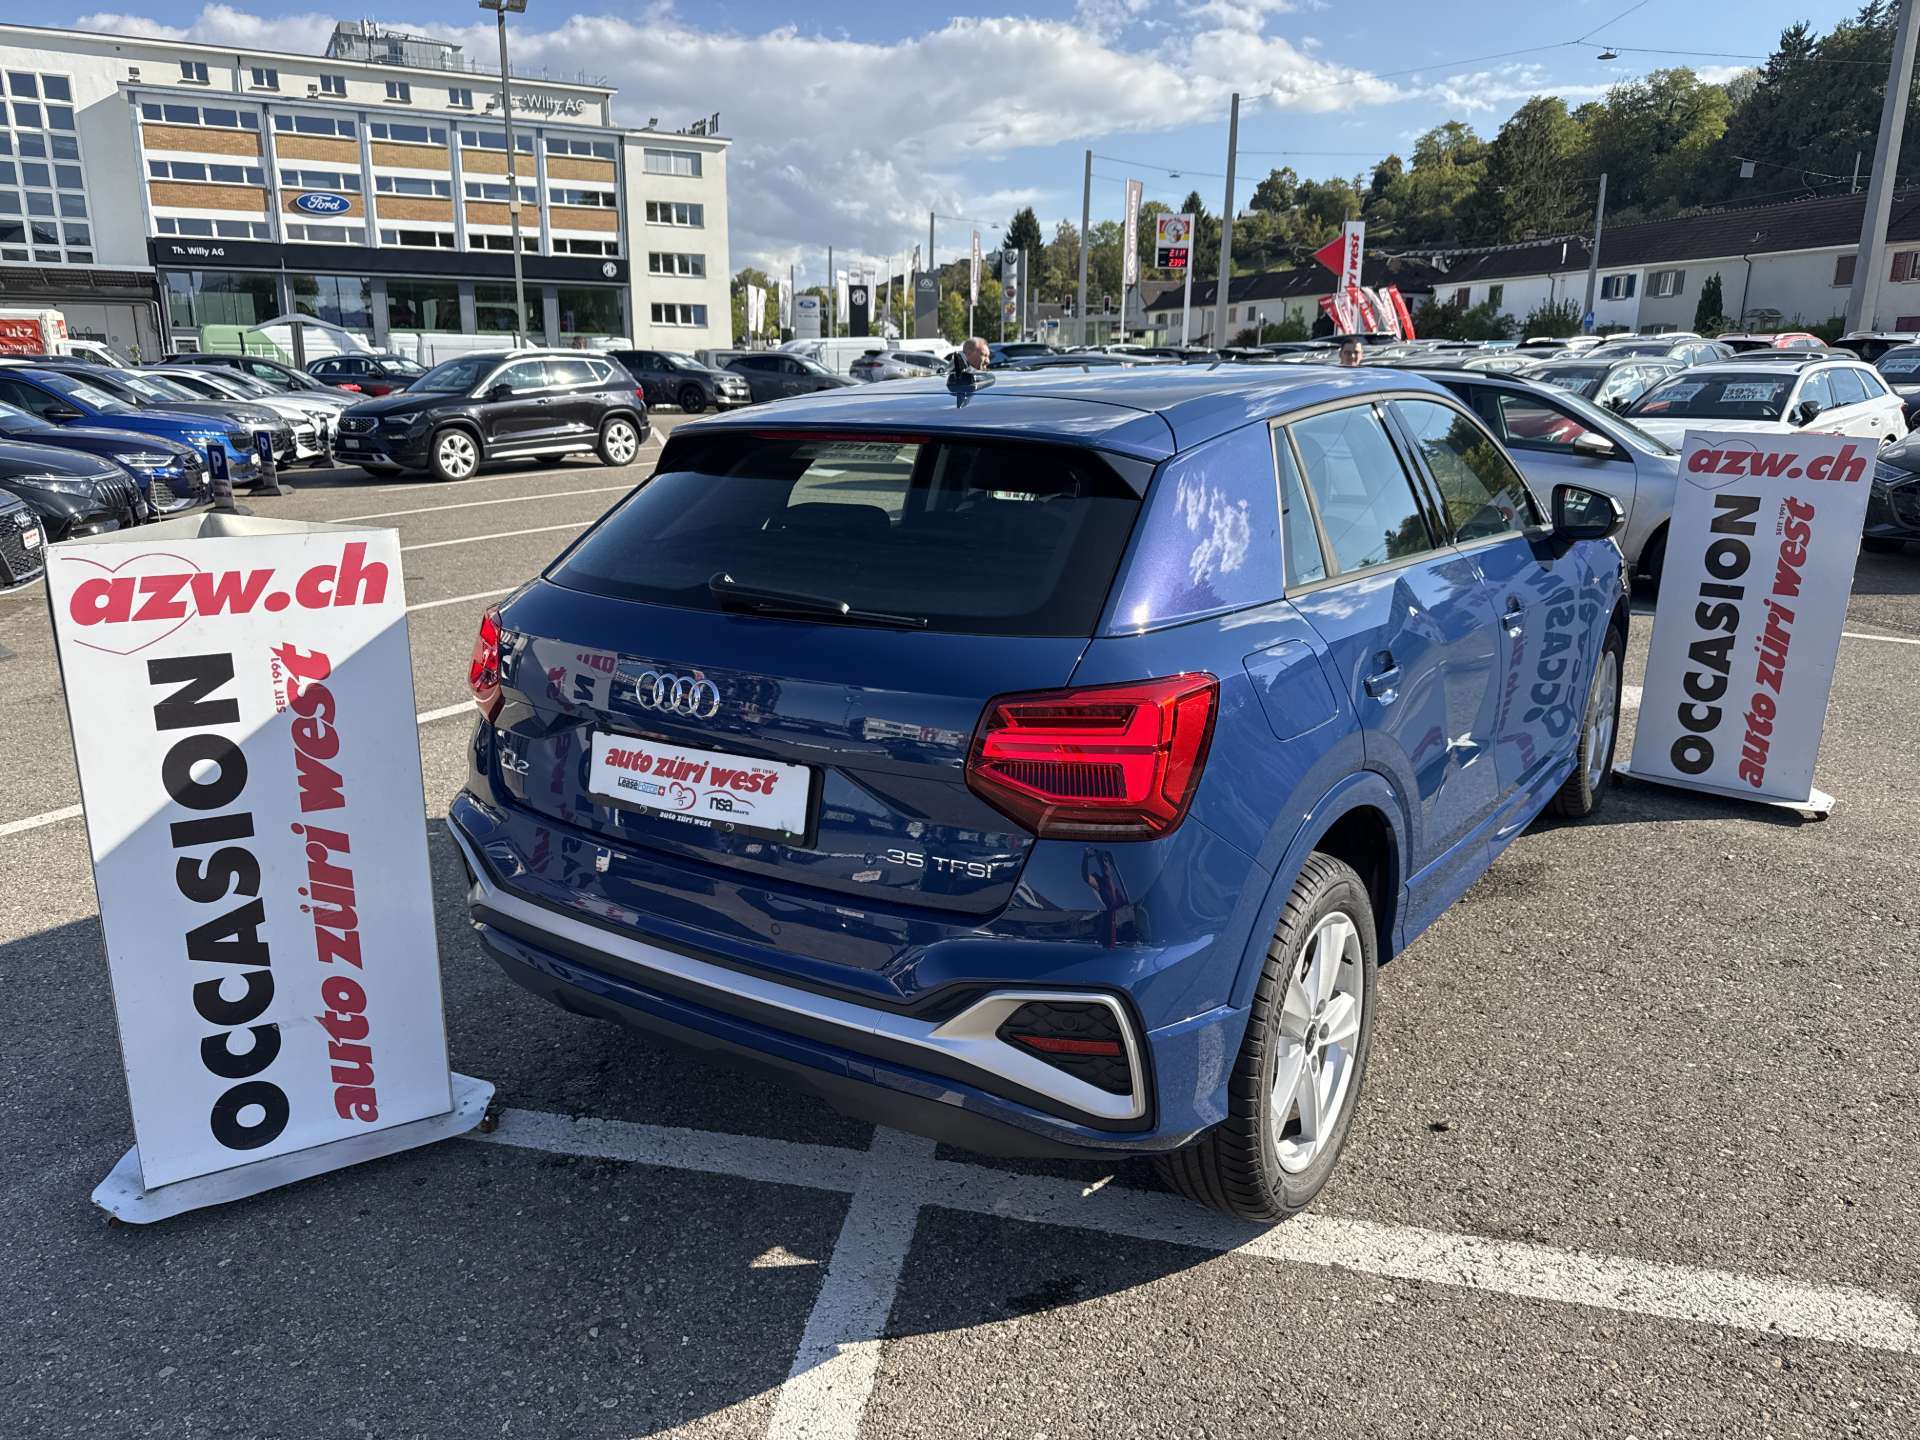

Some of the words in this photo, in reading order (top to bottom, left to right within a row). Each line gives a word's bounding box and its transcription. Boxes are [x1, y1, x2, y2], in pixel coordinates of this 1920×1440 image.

[527, 94, 561, 113] Willy
[565, 98, 586, 112] AG
[307, 196, 340, 210] Ford
[171, 246, 185, 254] Th.
[187, 247, 209, 256] Willy
[1350, 232, 1360, 270] west
[211, 451, 222, 474] P
[1688, 445, 1867, 482] azw.ch
[1772, 496, 1815, 598] west
[69, 542, 389, 626] azw.ch
[1670, 494, 1762, 775] OCCASION
[1754, 598, 1796, 695] züri
[270, 657, 284, 686] 1991
[275, 688, 287, 713] SEIT
[270, 641, 346, 813] west
[1739, 693, 1777, 788] auto
[605, 748, 653, 773] auto
[651, 755, 709, 783] züri
[710, 767, 779, 795] west
[659, 811, 677, 820] auto
[677, 815, 694, 824] züri
[694, 818, 712, 827] west
[710, 797, 733, 812] nsa
[887, 849, 924, 868] 35
[931, 856, 992, 879] TFSI
[147, 653, 290, 1151] OCCASION
[290, 822, 364, 970] züri
[313, 975, 379, 1123] auto
